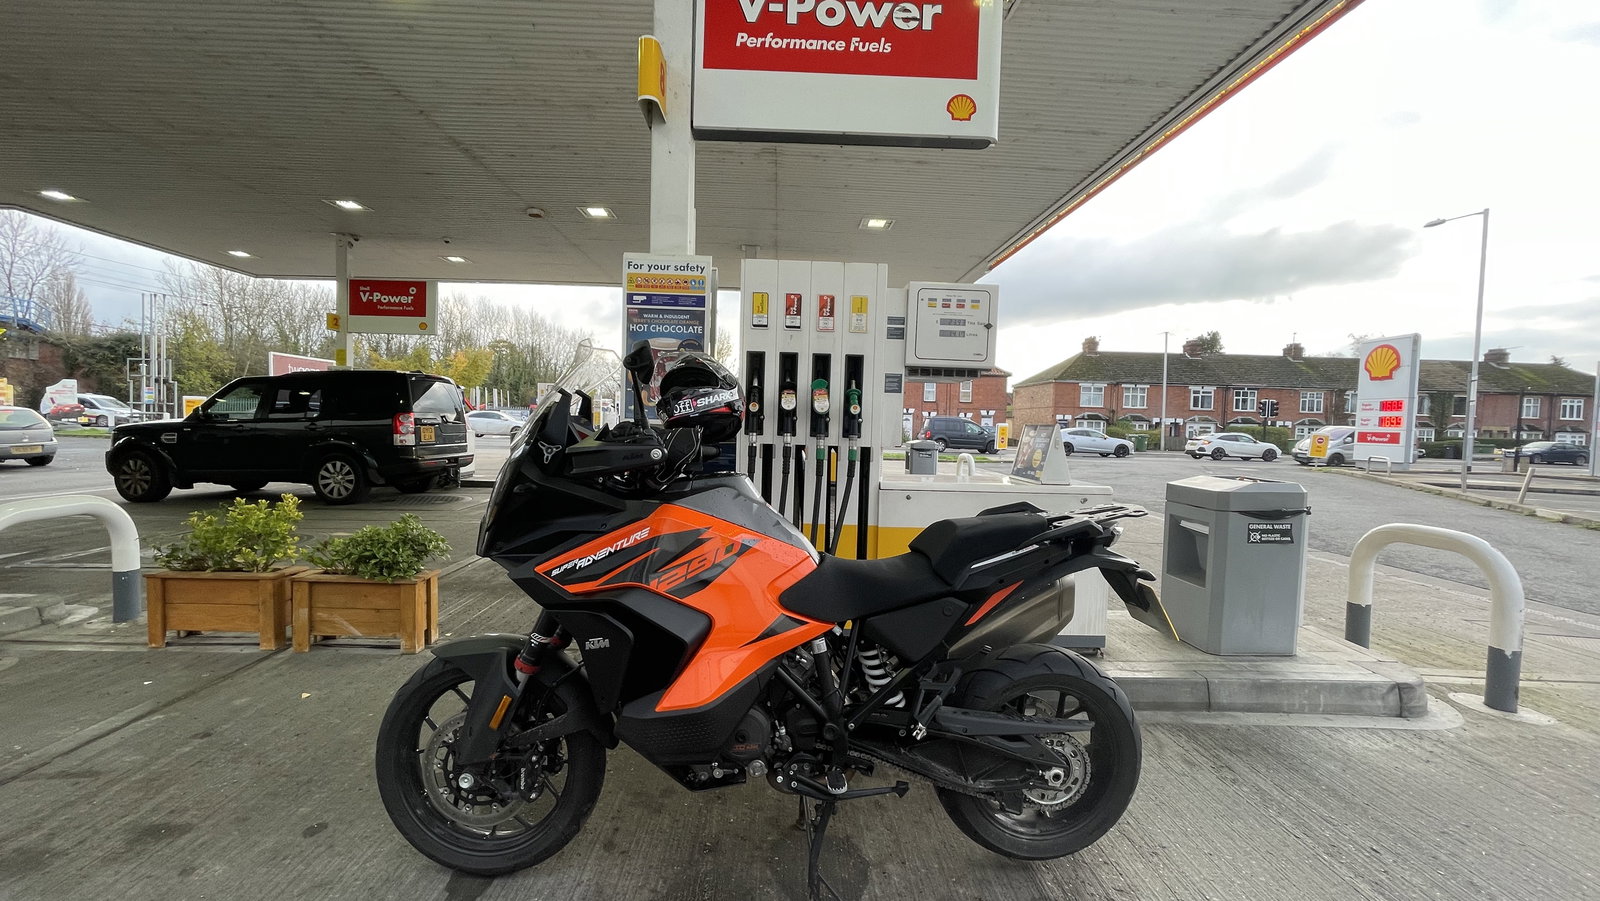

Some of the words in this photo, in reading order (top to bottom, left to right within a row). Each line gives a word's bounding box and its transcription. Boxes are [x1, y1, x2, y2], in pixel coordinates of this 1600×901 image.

[738, 0, 943, 31] V-Power
[735, 32, 846, 51] Performance
[849, 37, 892, 53] Fuels
[627, 261, 644, 270] For
[647, 263, 671, 272] your
[674, 263, 705, 274] safety
[360, 291, 414, 303] V-Power
[629, 324, 648, 332] HOT
[650, 324, 703, 334] CHOCOLATE
[697, 392, 731, 407] SHARK
[551, 558, 578, 577] SUPER
[576, 527, 651, 570] ADVENTURE
[649, 539, 743, 590] 1290
[585, 637, 610, 651] KTM
